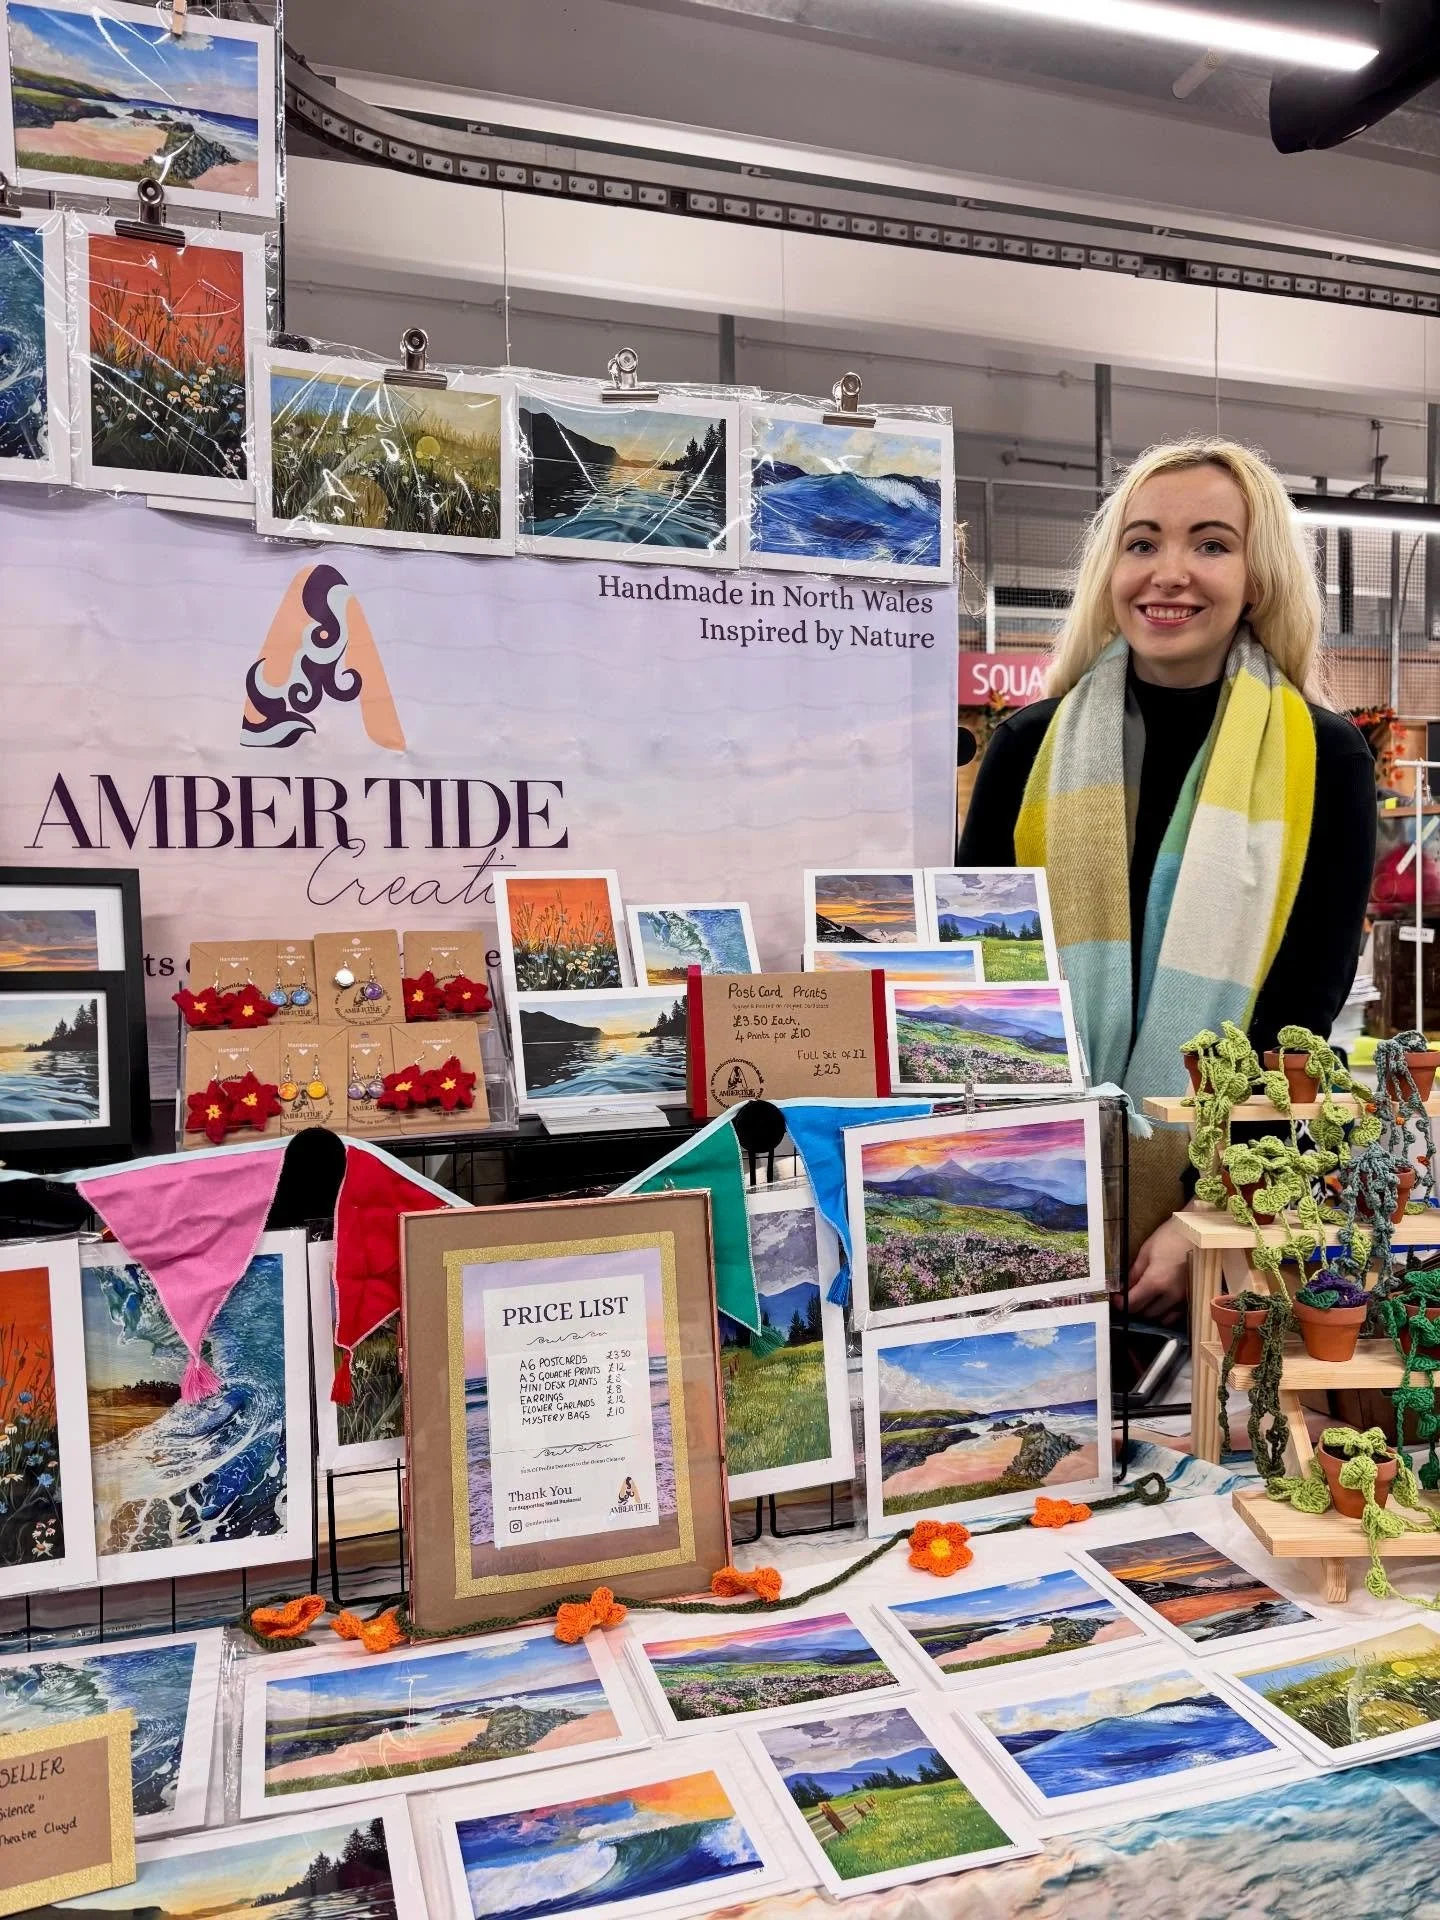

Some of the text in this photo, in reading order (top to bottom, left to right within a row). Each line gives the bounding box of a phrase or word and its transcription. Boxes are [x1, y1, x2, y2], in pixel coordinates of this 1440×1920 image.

[598, 574, 934, 614] Handmade in North Wales
[700, 617, 935, 650] Inspired by Nature
[972, 663, 1046, 700] SQUA
[306, 838, 516, 906] Creati
[728, 982, 756, 999] Post
[793, 985, 828, 1000] Prints
[733, 1015, 768, 1028] £3.50
[735, 1028, 811, 1043] 4 Prints for £10
[797, 1049, 817, 1060] Full
[822, 1050, 837, 1059] Set
[813, 1063, 841, 1077] £25
[502, 1296, 629, 1327] PRICE LIST
[539, 1355, 588, 1369] POSTCARDS
[538, 1369, 572, 1381] GOUACHE
[574, 1366, 601, 1377] PRINTS
[520, 1383, 541, 1394] MINI
[544, 1381, 566, 1391] DESK
[568, 1377, 598, 1388] PLANTS
[520, 1393, 564, 1405] EARRINGS
[522, 1403, 553, 1415] FLOWER
[556, 1398, 596, 1412] GARLANDS
[522, 1406, 625, 1426] MYSTERY BAGS £10
[508, 1485, 572, 1503] Thank You
[517, 1502, 545, 1511] Supporting
[44, 1816, 78, 1835] Clwyd
